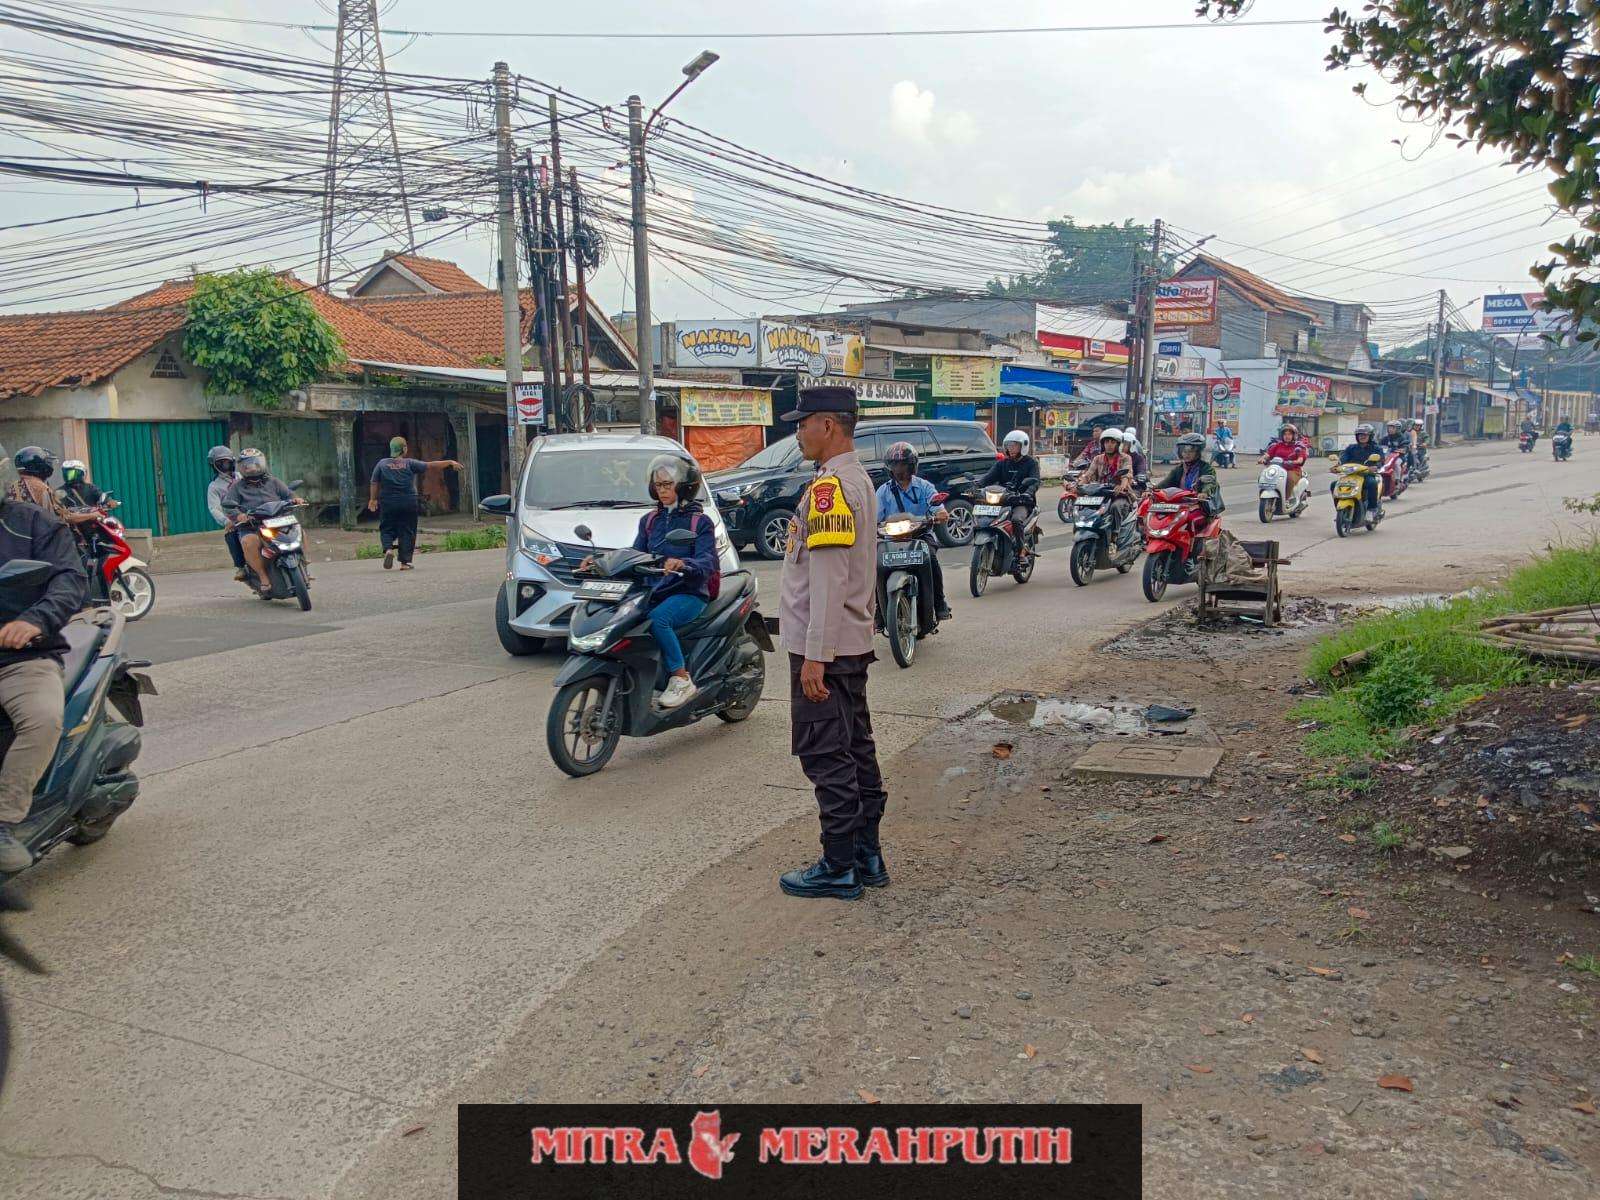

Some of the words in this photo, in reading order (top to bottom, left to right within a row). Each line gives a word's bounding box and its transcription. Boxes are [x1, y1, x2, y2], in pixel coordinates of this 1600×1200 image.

[1486, 299, 1522, 308] MEGA
[694, 342, 739, 357] SABLON
[1279, 374, 1327, 392] MARTABAK
[866, 383, 874, 399] &
[876, 384, 914, 400] SABLON
